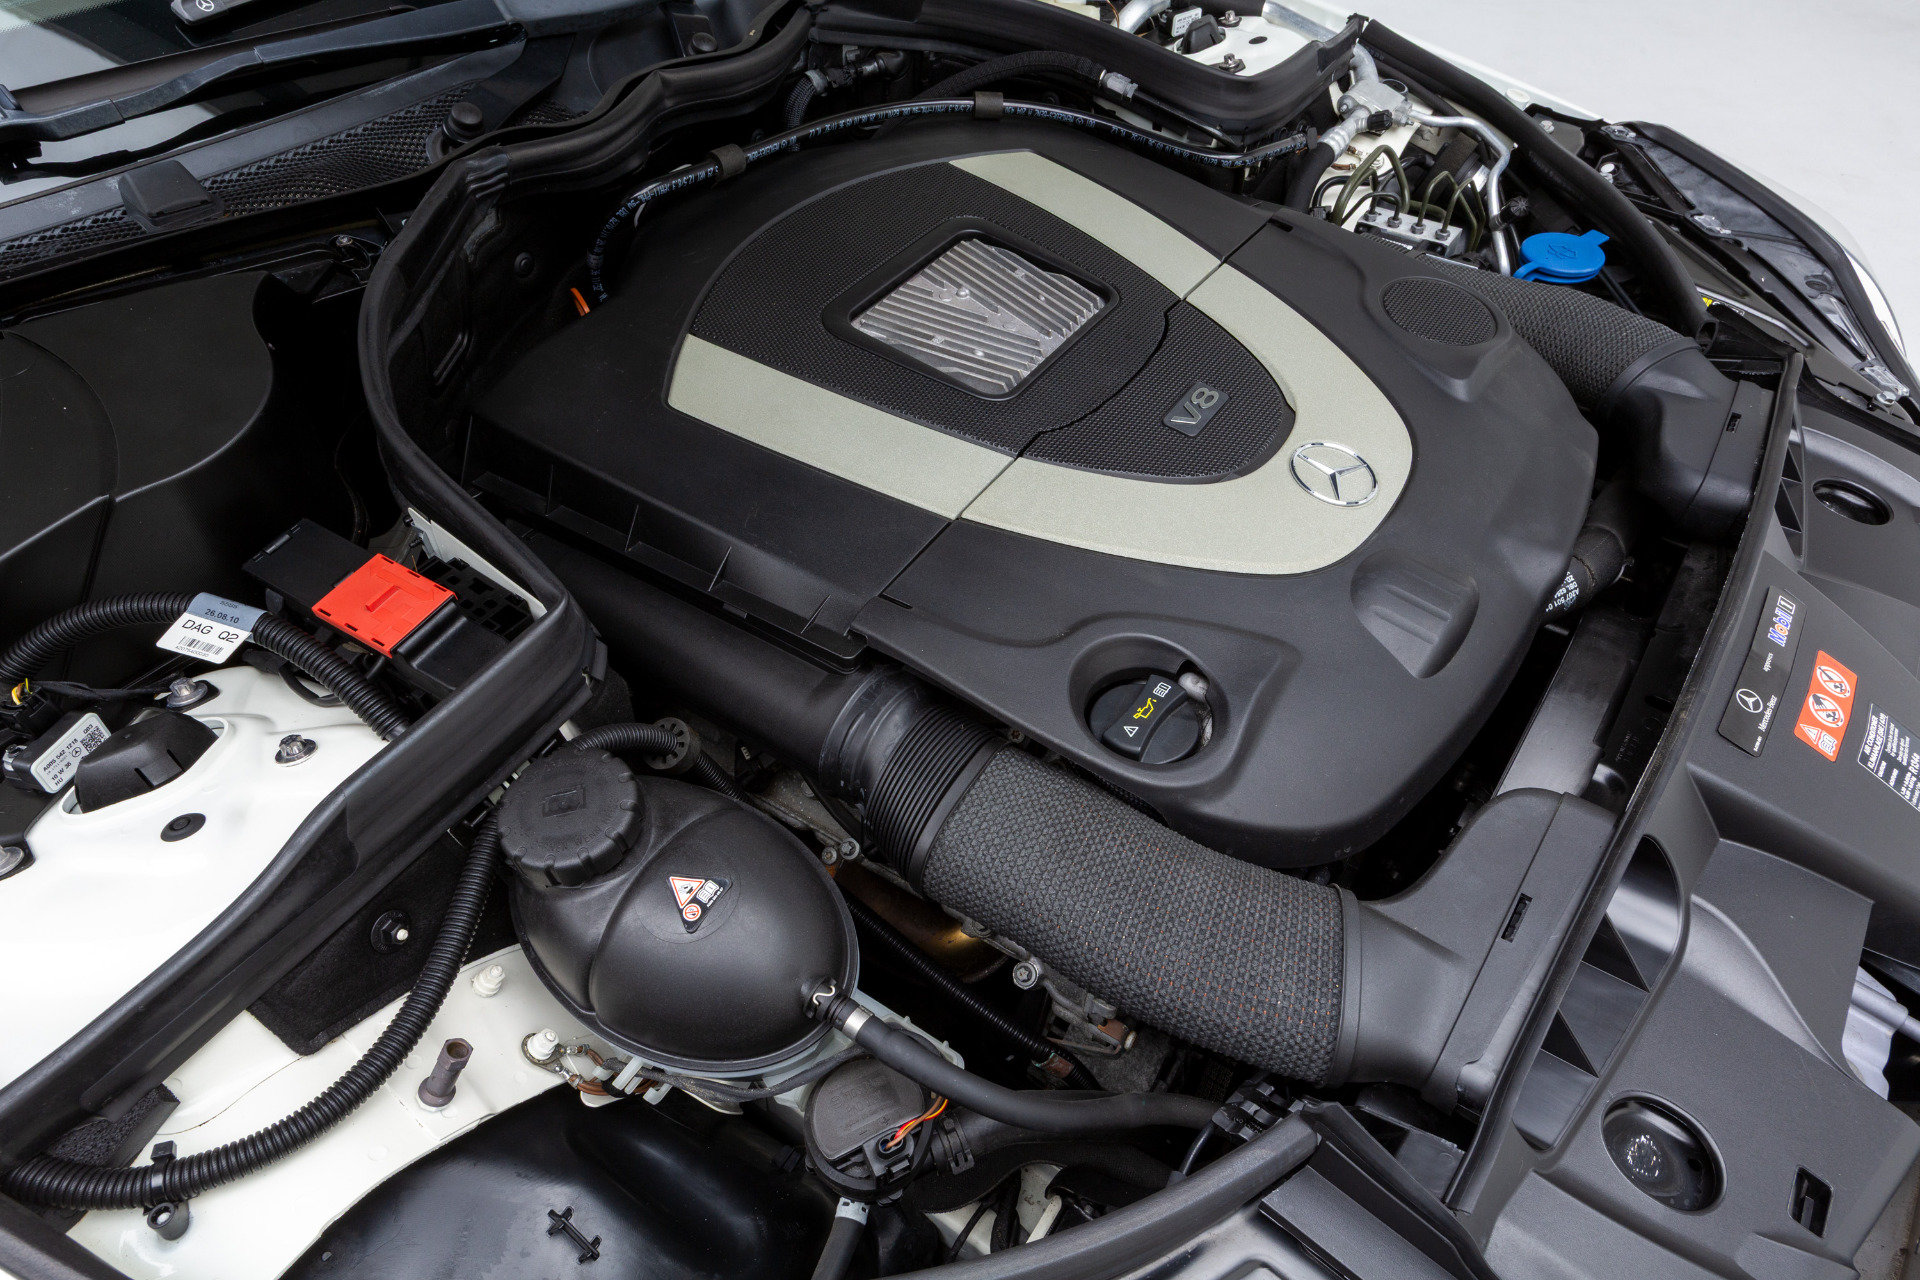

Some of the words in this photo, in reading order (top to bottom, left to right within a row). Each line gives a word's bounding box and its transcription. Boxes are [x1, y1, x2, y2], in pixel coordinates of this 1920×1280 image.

[1171, 387, 1219, 425] V8
[181, 619, 213, 635] DAG
[217, 630, 239, 643] Q2
[204, 608, 240, 624] 26.08.10
[1768, 607, 1793, 647] Mobil
